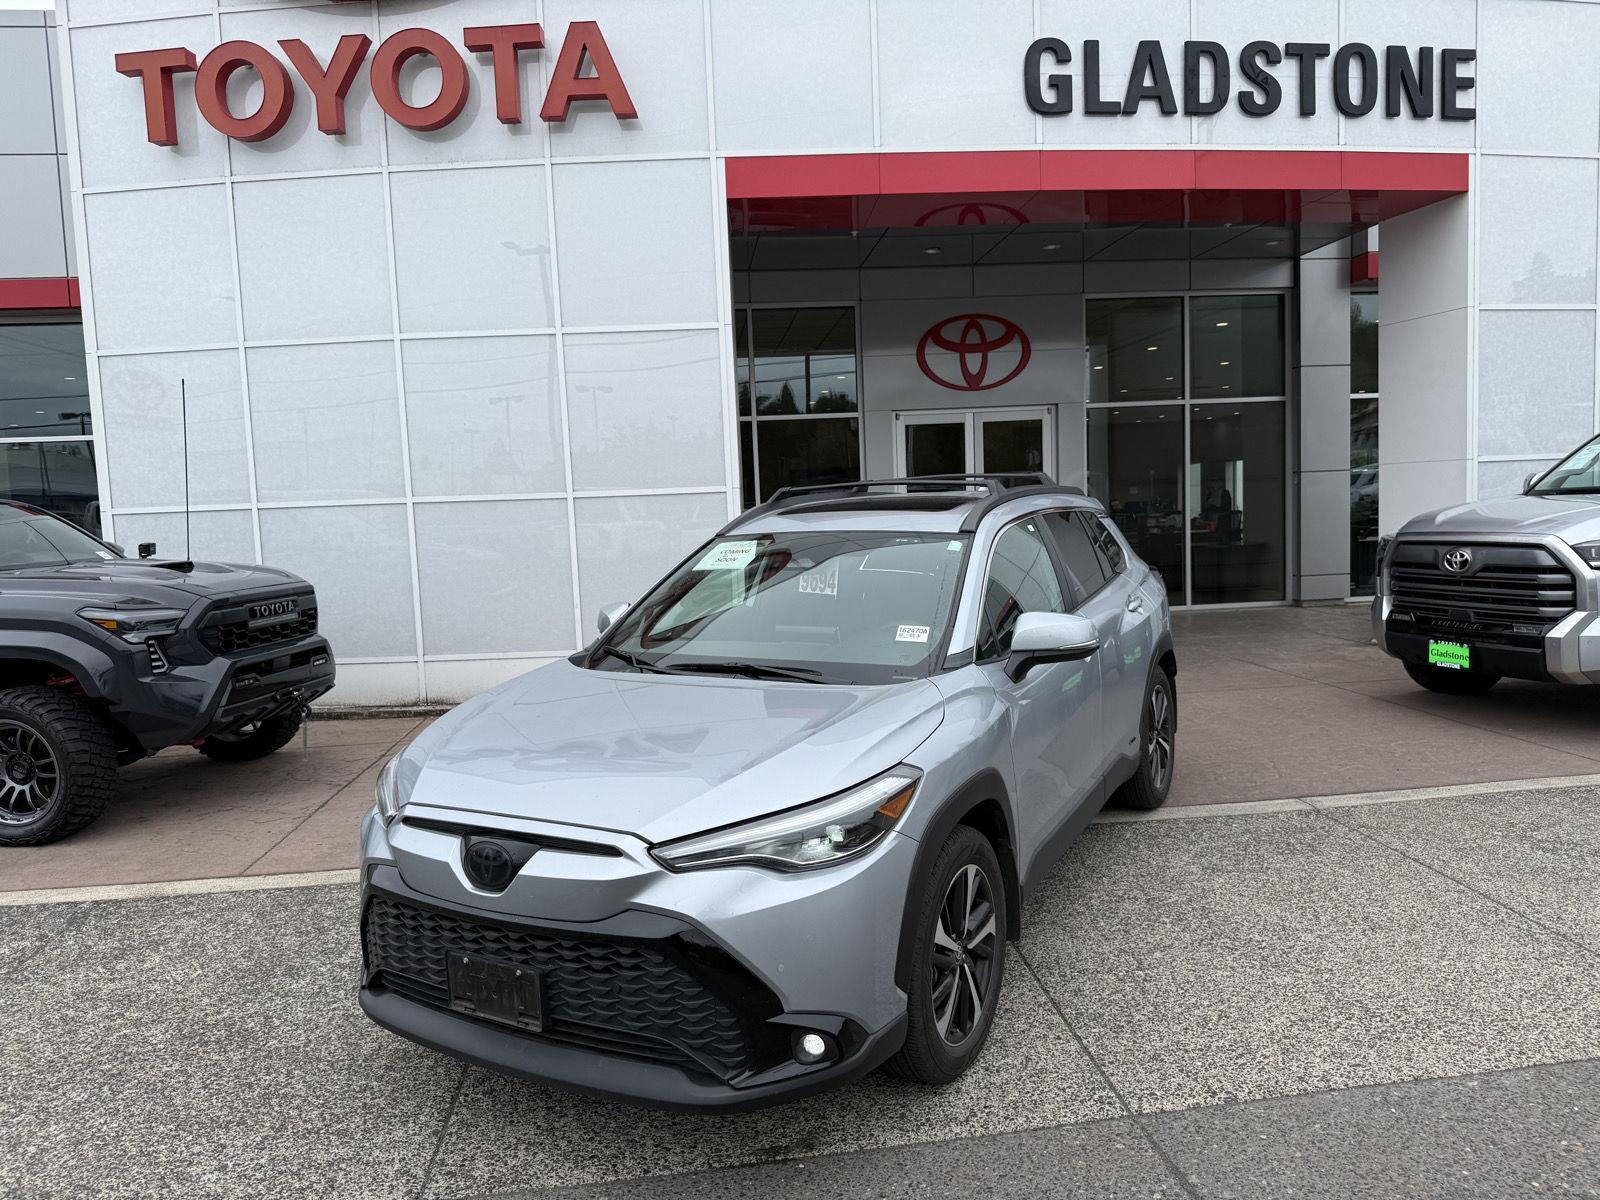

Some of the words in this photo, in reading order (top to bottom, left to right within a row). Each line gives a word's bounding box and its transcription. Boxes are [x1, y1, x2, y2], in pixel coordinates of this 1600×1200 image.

[115, 21, 638, 147] TOYOTA
[1024, 37, 1477, 120] GLADSTONE
[253, 600, 295, 617] TOYOTA
[1430, 648, 1471, 661] Gladstone
